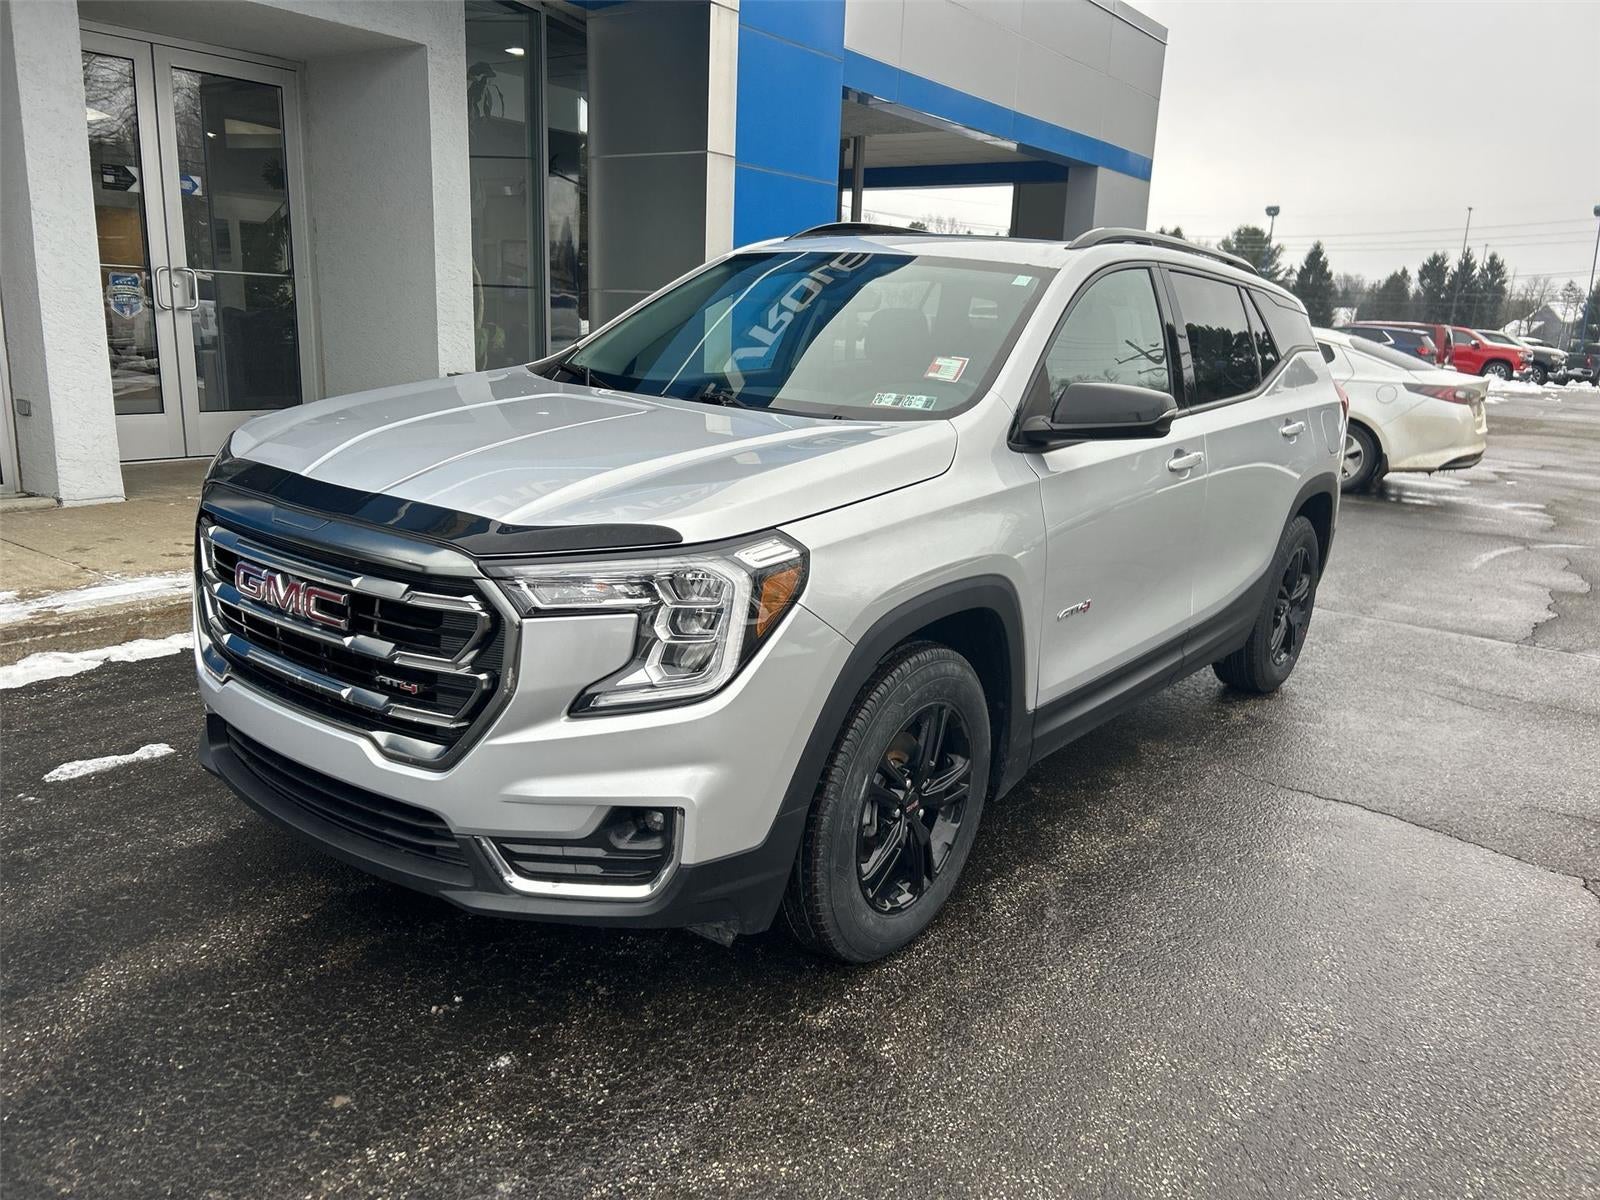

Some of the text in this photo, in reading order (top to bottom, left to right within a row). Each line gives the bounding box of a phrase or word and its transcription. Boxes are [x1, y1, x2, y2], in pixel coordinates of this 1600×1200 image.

[904, 395, 915, 407] 26
[235, 560, 349, 631] GMC
[375, 674, 418, 695] AT4
